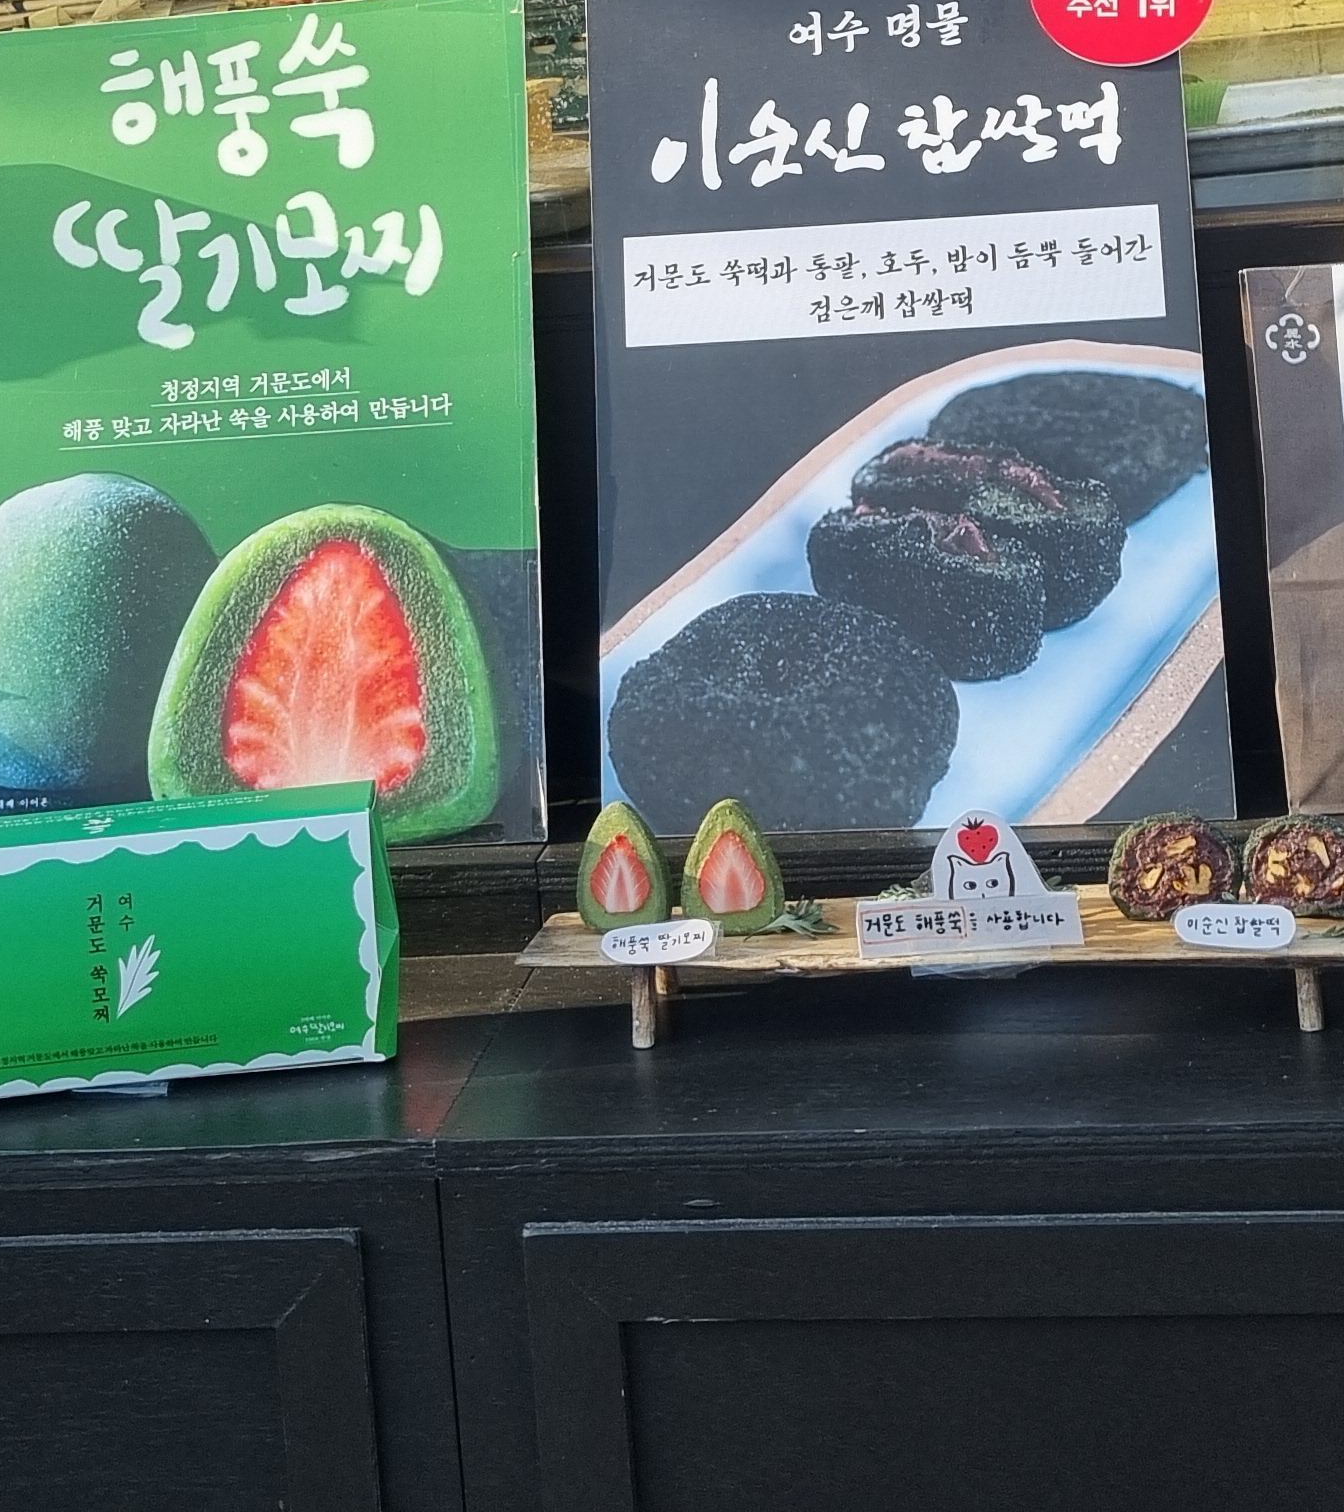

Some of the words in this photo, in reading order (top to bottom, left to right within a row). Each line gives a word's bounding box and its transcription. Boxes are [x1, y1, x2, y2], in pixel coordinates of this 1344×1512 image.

[788, 9, 870, 55] 여수
[886, 1, 969, 48] 명물
[99, 13, 376, 178] 해풍쑥
[651, 77, 886, 191] 이순신
[897, 82, 1123, 175] 찹쌀떡
[52, 190, 444, 350] 딸기모찌
[633, 263, 711, 290] 거문도
[719, 256, 797, 286] 쑥떡과
[805, 250, 868, 281] 통팥,
[876, 249, 938, 278] 호두,
[946, 245, 998, 273] 밤이
[1006, 240, 1061, 270] 듬뿍
[1070, 234, 1152, 263] 들어간
[893, 287, 974, 318] 찹쌀떡
[161, 374, 241, 403] 청정지역
[249, 367, 352, 395] 거문도에서
[62, 418, 104, 442] 해풍
[111, 412, 152, 438] 맞고
[159, 408, 222, 437] 자라난
[230, 405, 272, 431] 쑥을
[278, 399, 359, 428] 사용하여
[368, 393, 452, 421] 만듭니다
[86, 893, 106, 954] 거문도
[118, 892, 134, 932] 여수
[866, 912, 907, 935] 거문도
[986, 910, 1065, 930] 사용합니다
[1235, 916, 1280, 937] 찹쌀떡
[612, 934, 649, 955] 해풍쑥
[658, 931, 705, 951] 딸기모찌
[89, 965, 110, 1023] 쑥모찌
